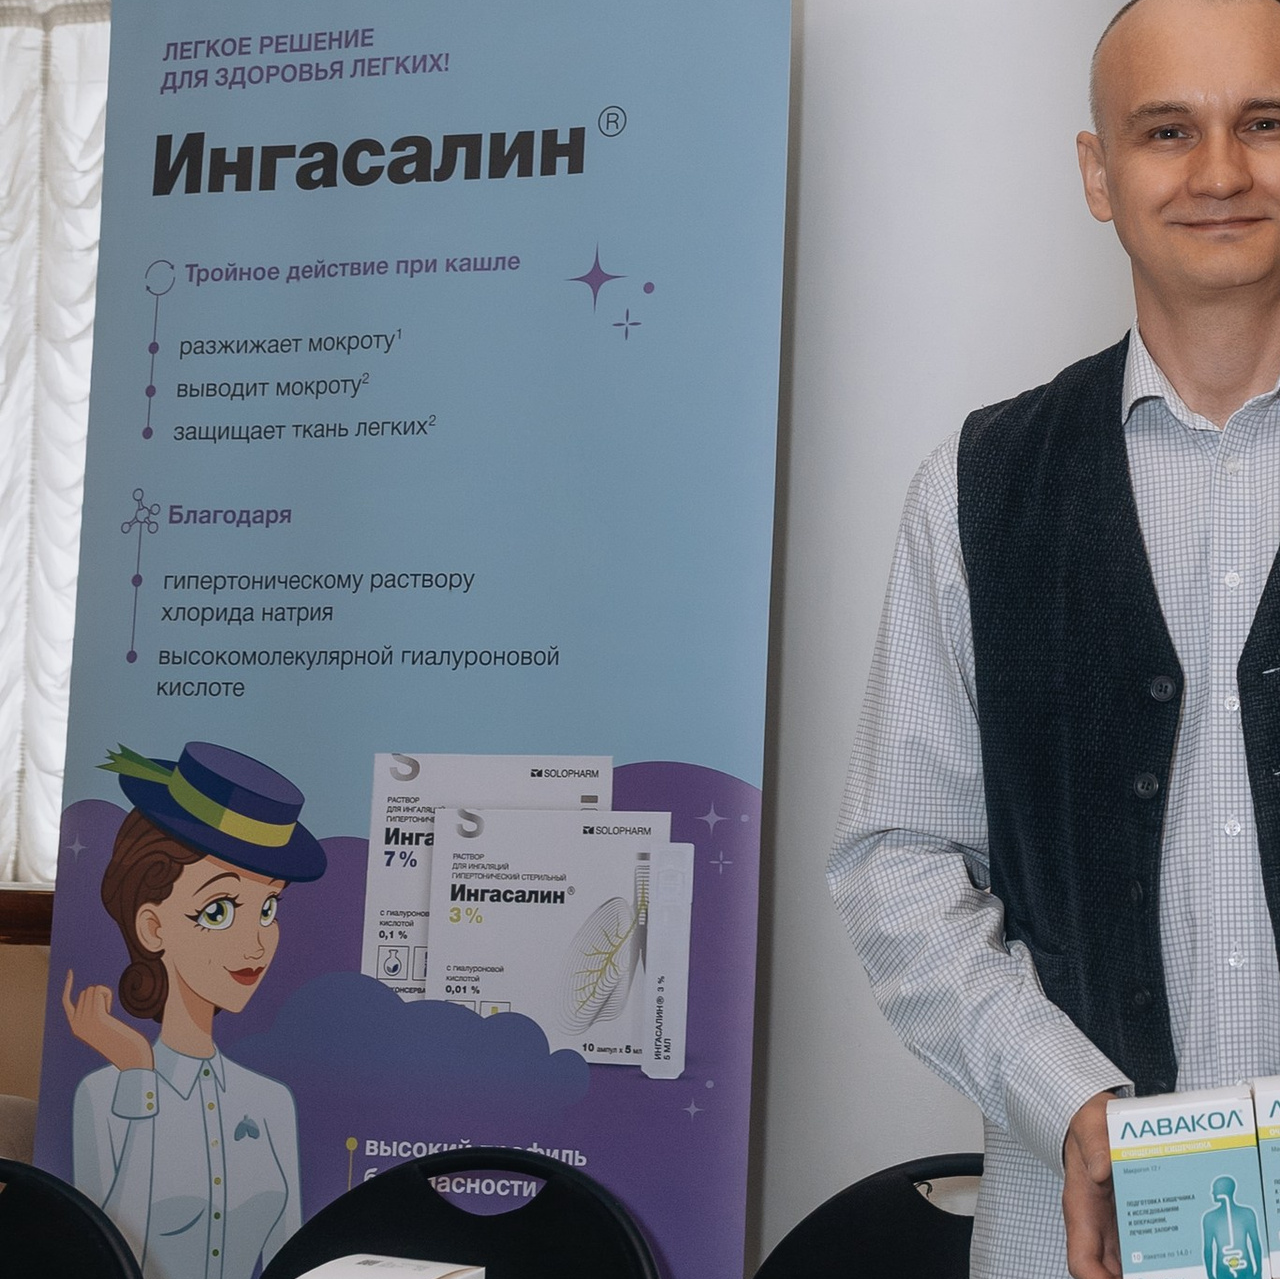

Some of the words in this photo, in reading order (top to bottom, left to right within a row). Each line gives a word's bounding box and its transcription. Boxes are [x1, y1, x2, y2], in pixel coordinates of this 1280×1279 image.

[162, 37, 253, 63] ЛЕГКОЕ
[258, 28, 375, 56] РЕШЕНИЕ
[160, 69, 210, 95] ДЛЯ
[214, 61, 345, 90] ЗДОРОВЬЯ
[350, 53, 451, 79] ЛЕГКИХ!
[185, 259, 280, 285] Тройное
[286, 255, 389, 283] действие
[395, 257, 438, 278] при
[444, 253, 521, 274] кашле
[179, 337, 302, 359] разжижает
[176, 379, 269, 402] выводит
[173, 423, 286, 445] защищает
[292, 421, 349, 440] ткань
[168, 504, 292, 529] Благодаря
[163, 572, 364, 594] гипертоническому
[370, 571, 475, 593] раствору
[161, 603, 255, 625] хлорида
[261, 603, 334, 624] натрия
[158, 646, 394, 670] высокомолекулярной
[400, 645, 560, 670] гиалуроновой
[156, 678, 245, 698] кислоте
[544, 768, 599, 779] SOLOPHARM
[386, 805, 401, 814] ДЛЯ
[387, 796, 420, 804] РАСТВОР
[595, 826, 651, 836] SOLOPHARM
[384, 850, 396, 867] 7
[399, 850, 418, 868] %
[449, 906, 462, 923] 3
[465, 907, 483, 924] %
[378, 930, 394, 941] 0,1
[445, 985, 467, 995] 0,01
[582, 1042, 595, 1053] 10
[625, 1044, 632, 1055] 5
[1120, 1110, 1244, 1140] ЛАВАКОЛ
